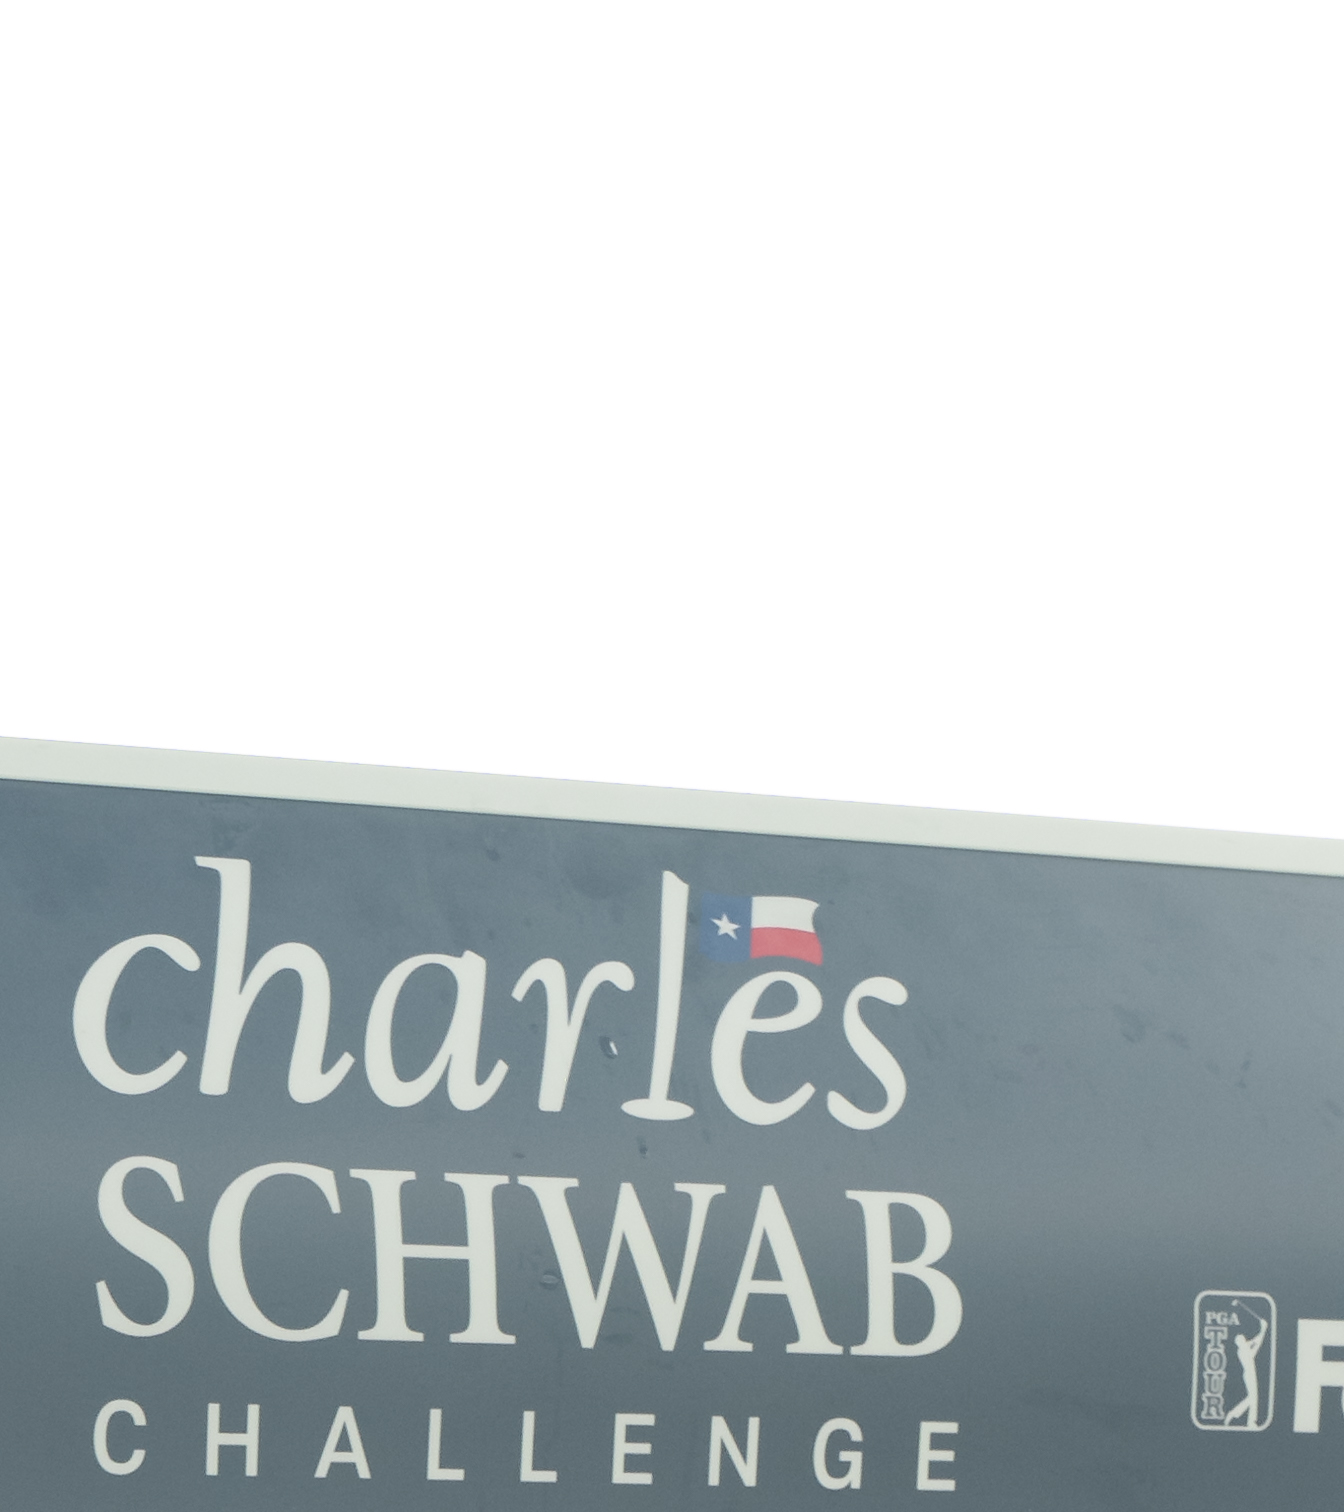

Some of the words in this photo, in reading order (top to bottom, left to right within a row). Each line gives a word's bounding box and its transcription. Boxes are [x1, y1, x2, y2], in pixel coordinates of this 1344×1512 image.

[72, 855, 908, 1130] charles
[96, 1155, 964, 1358] SCHWAB
[1204, 1310, 1242, 1326] PGA
[1200, 1325, 1229, 1420] TOUR
[93, 1399, 959, 1491] CHALLENGE
